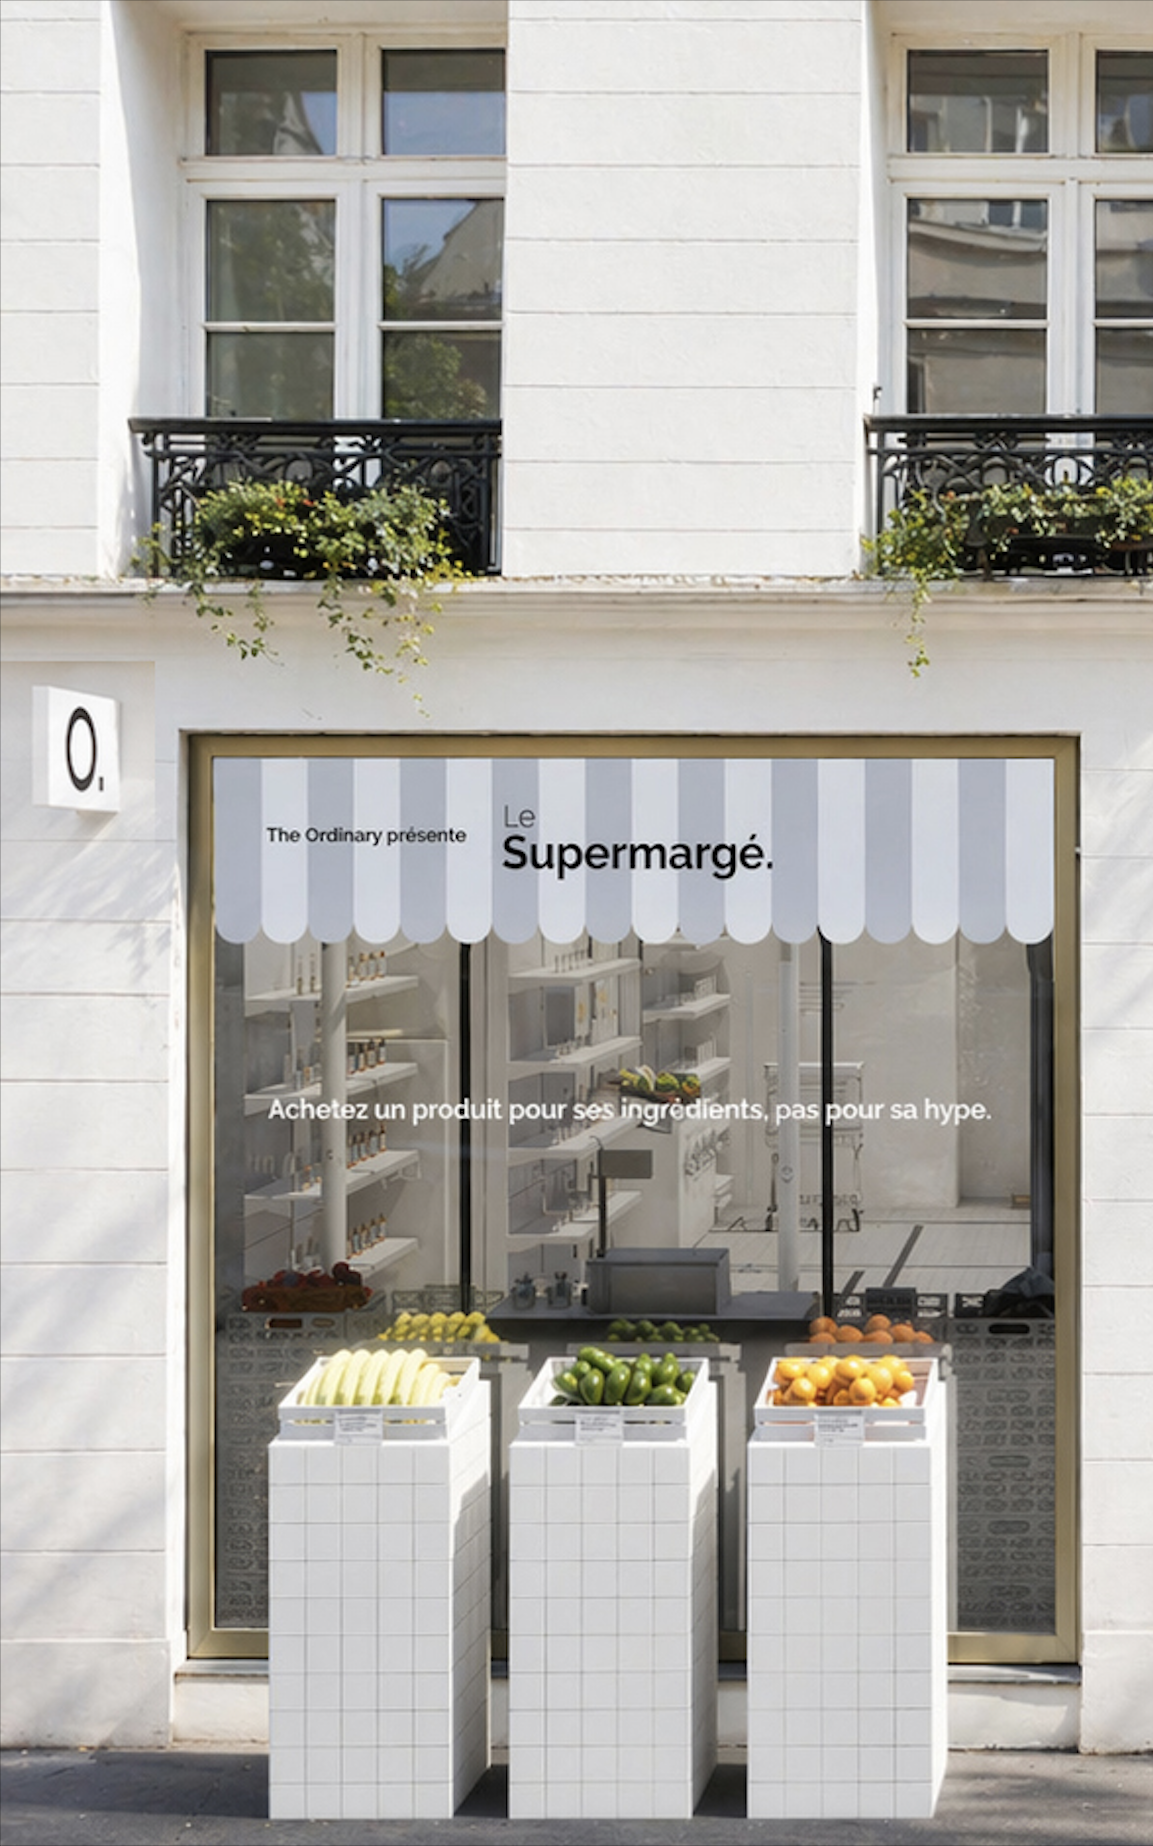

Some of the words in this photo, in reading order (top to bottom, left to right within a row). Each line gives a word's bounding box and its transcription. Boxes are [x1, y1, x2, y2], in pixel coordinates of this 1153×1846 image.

[66, 706, 104, 792] O.
[504, 804, 537, 829] Le
[266, 827, 301, 843] The
[304, 827, 383, 846] Ordinary
[387, 827, 467, 846] présente
[502, 832, 774, 881] Supermargé.
[268, 1098, 368, 1119] Achetez
[375, 1104, 405, 1119] un
[413, 1098, 502, 1125] produit
[509, 1104, 567, 1125] pour
[573, 1104, 614, 1119] ses
[621, 1098, 769, 1125] ingrédients,
[776, 1104, 819, 1125] pas
[826, 1104, 885, 1125] pour
[890, 1104, 918, 1119] sa
[925, 1098, 992, 1125] hype.
